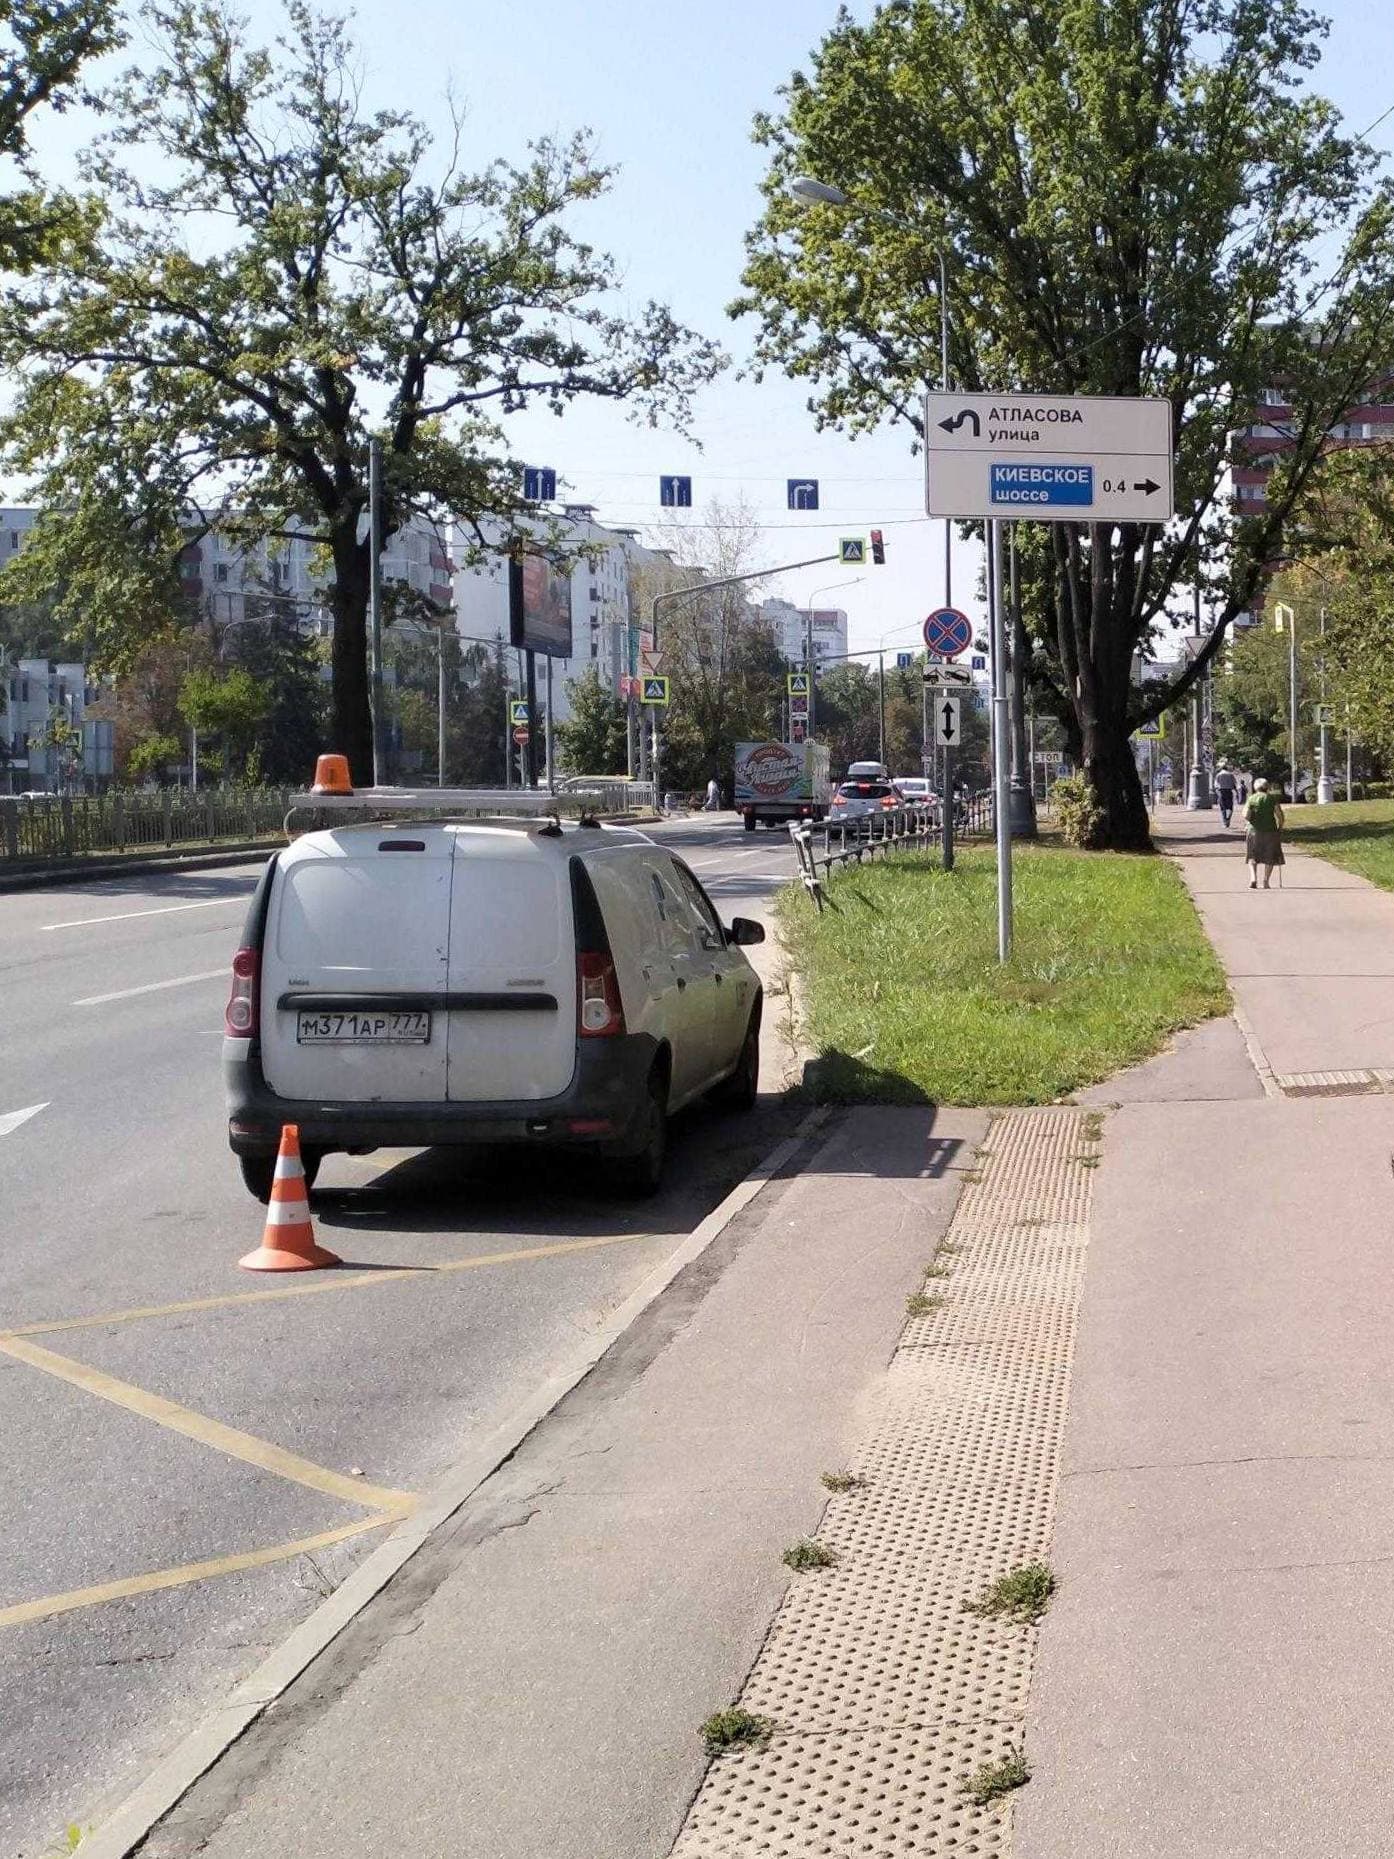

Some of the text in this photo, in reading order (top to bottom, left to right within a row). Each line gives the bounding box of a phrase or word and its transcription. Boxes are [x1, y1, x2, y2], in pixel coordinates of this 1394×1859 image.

[988, 407, 1083, 423] АТЛАСОВА
[988, 428, 1040, 442] улица
[995, 467, 1090, 484] КИЕВСКОЕ
[1103, 480, 1126, 493] 0.4
[995, 491, 1049, 502] шоссе
